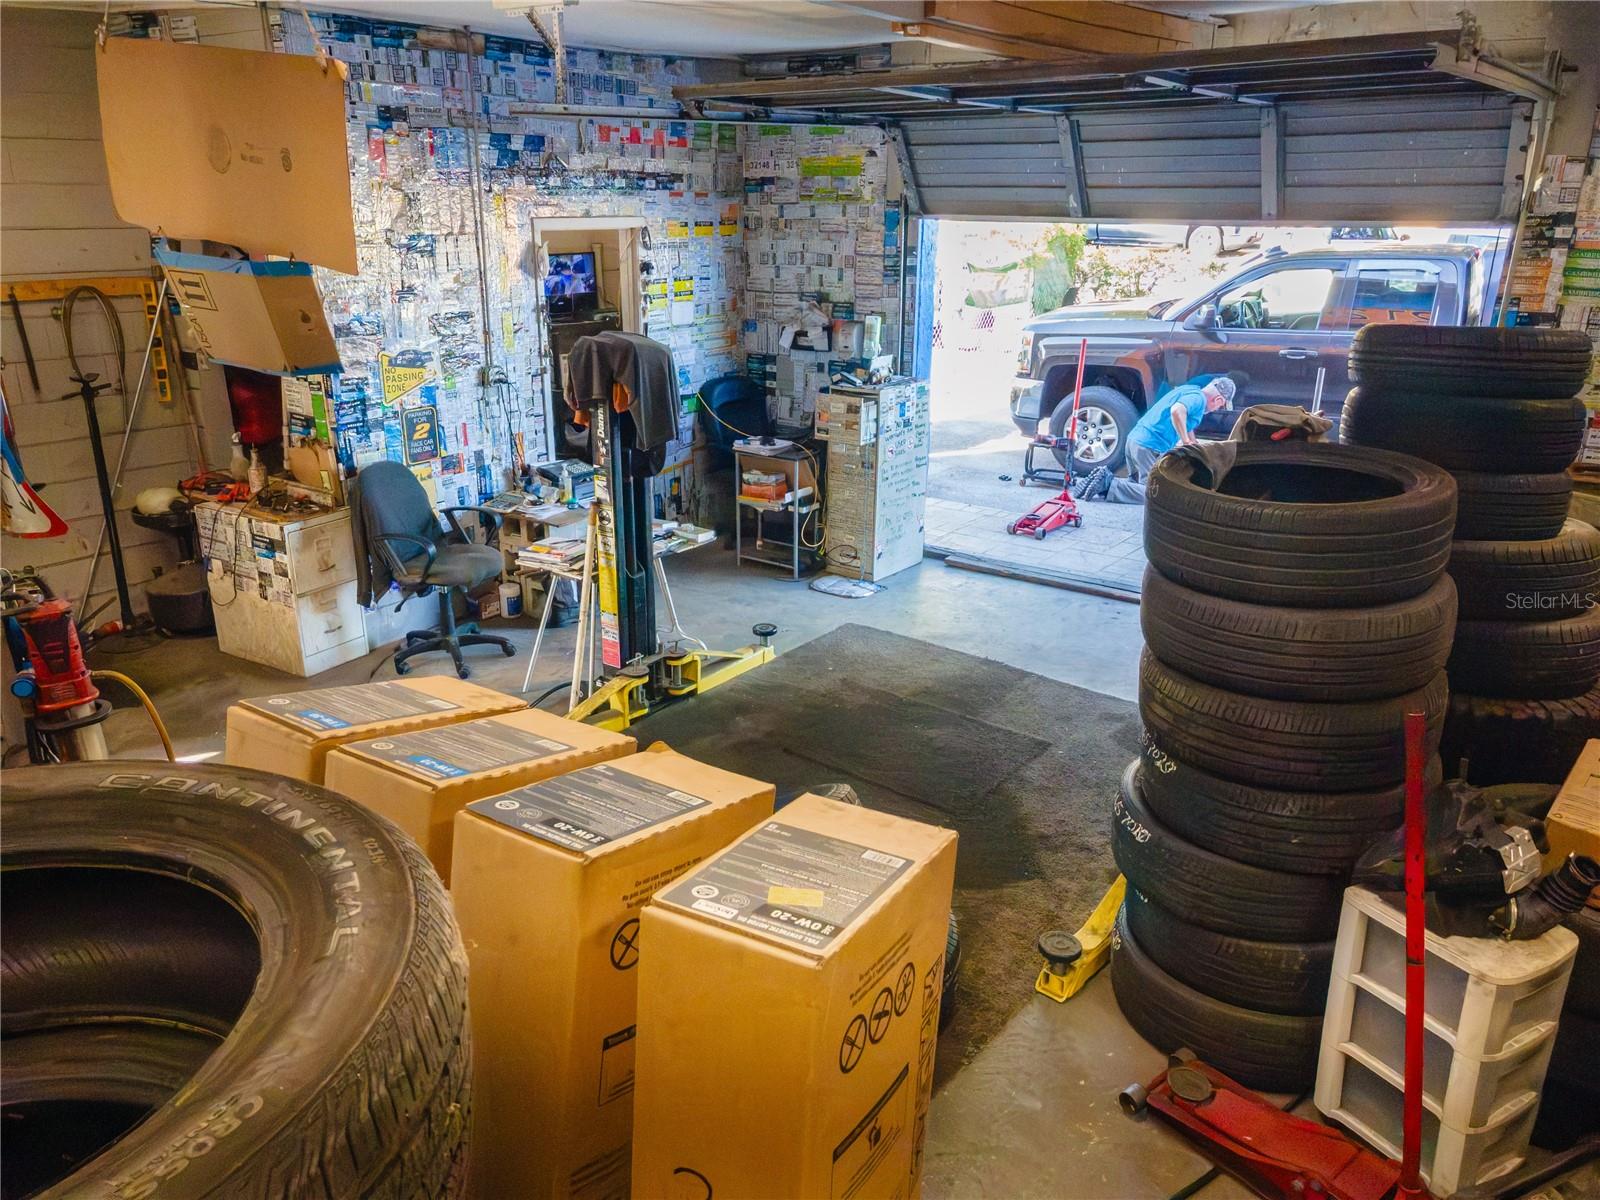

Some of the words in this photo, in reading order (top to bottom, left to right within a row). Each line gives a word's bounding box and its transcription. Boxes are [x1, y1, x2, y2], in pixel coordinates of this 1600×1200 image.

[384, 367, 397, 375] NO
[385, 371, 424, 384] PASSING
[386, 383, 407, 394] ZONE
[407, 409, 433, 419] PARKING
[413, 422, 430, 440] 2
[98, 773, 362, 957] CONTINENTAL
[770, 909, 822, 931] 0W-20
